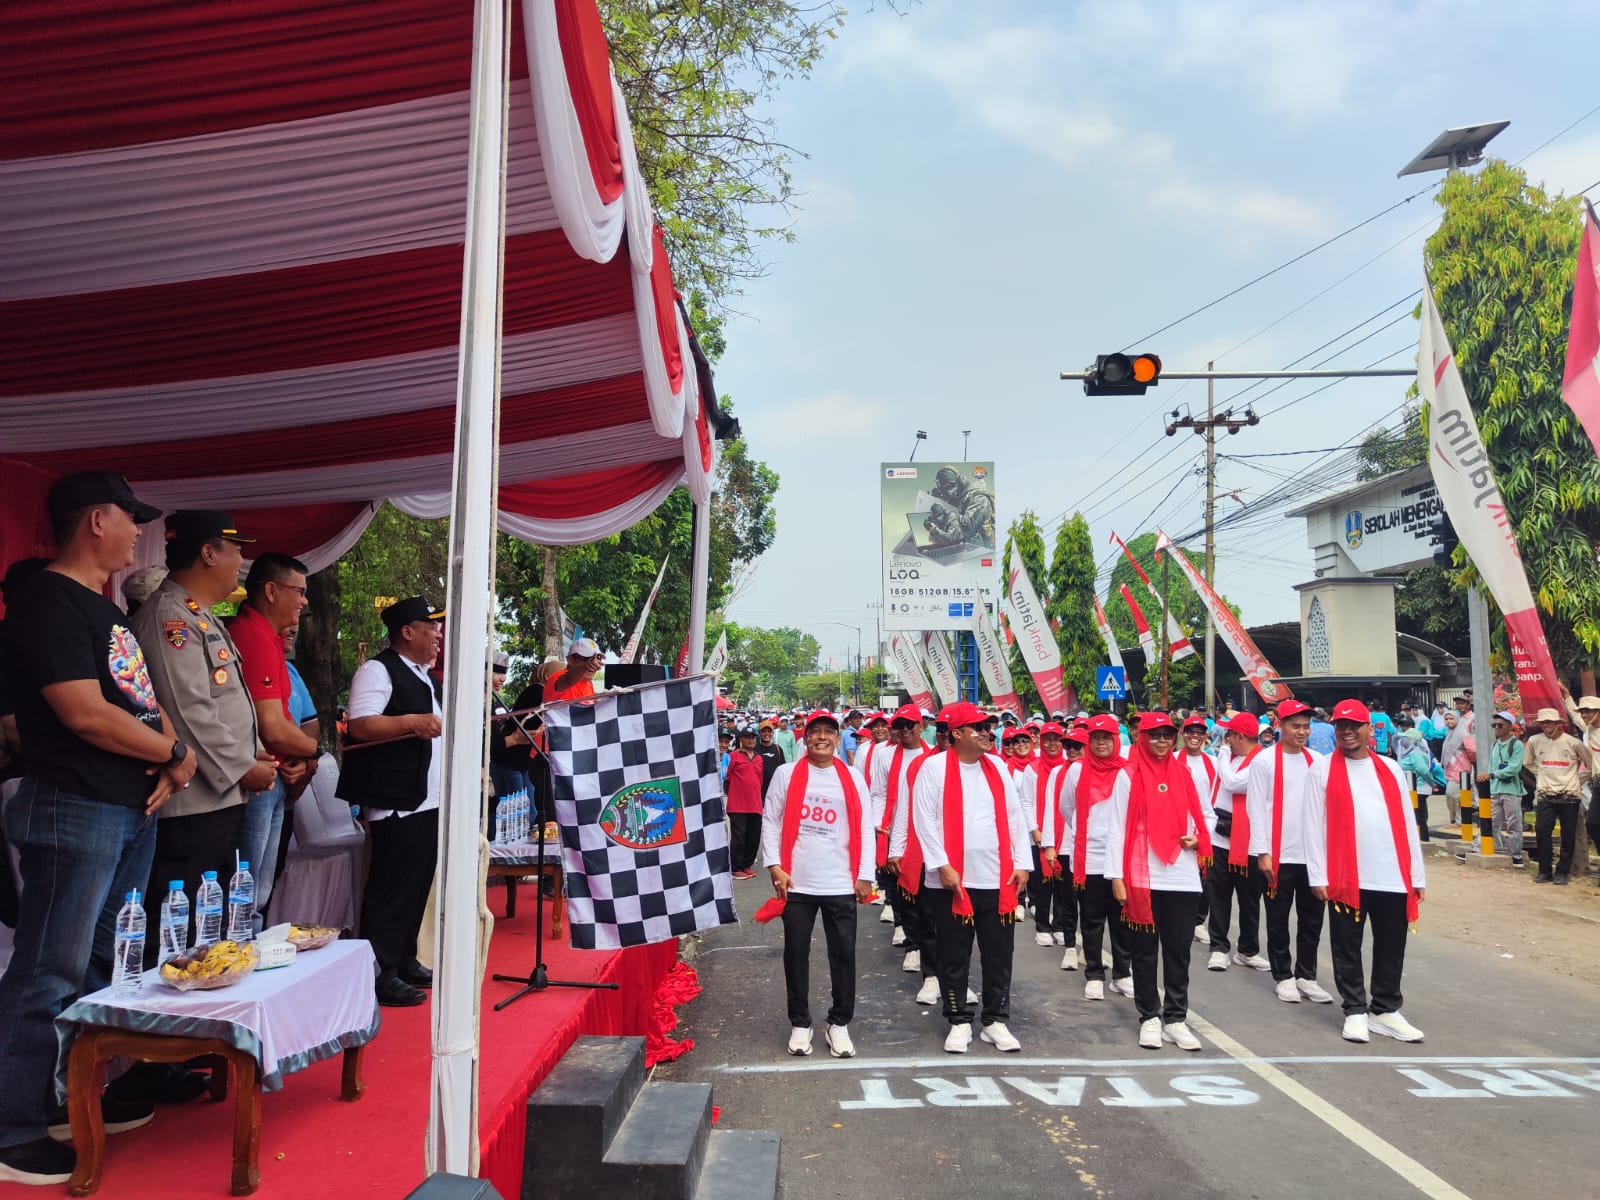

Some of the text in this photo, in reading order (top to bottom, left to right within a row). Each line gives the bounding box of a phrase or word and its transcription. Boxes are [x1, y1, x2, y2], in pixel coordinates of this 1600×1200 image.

[1364, 509, 1401, 535] SEKOLAH
[889, 560, 922, 568] Lenovo
[889, 569, 920, 580] LOQ
[839, 1075, 1261, 1109] START
